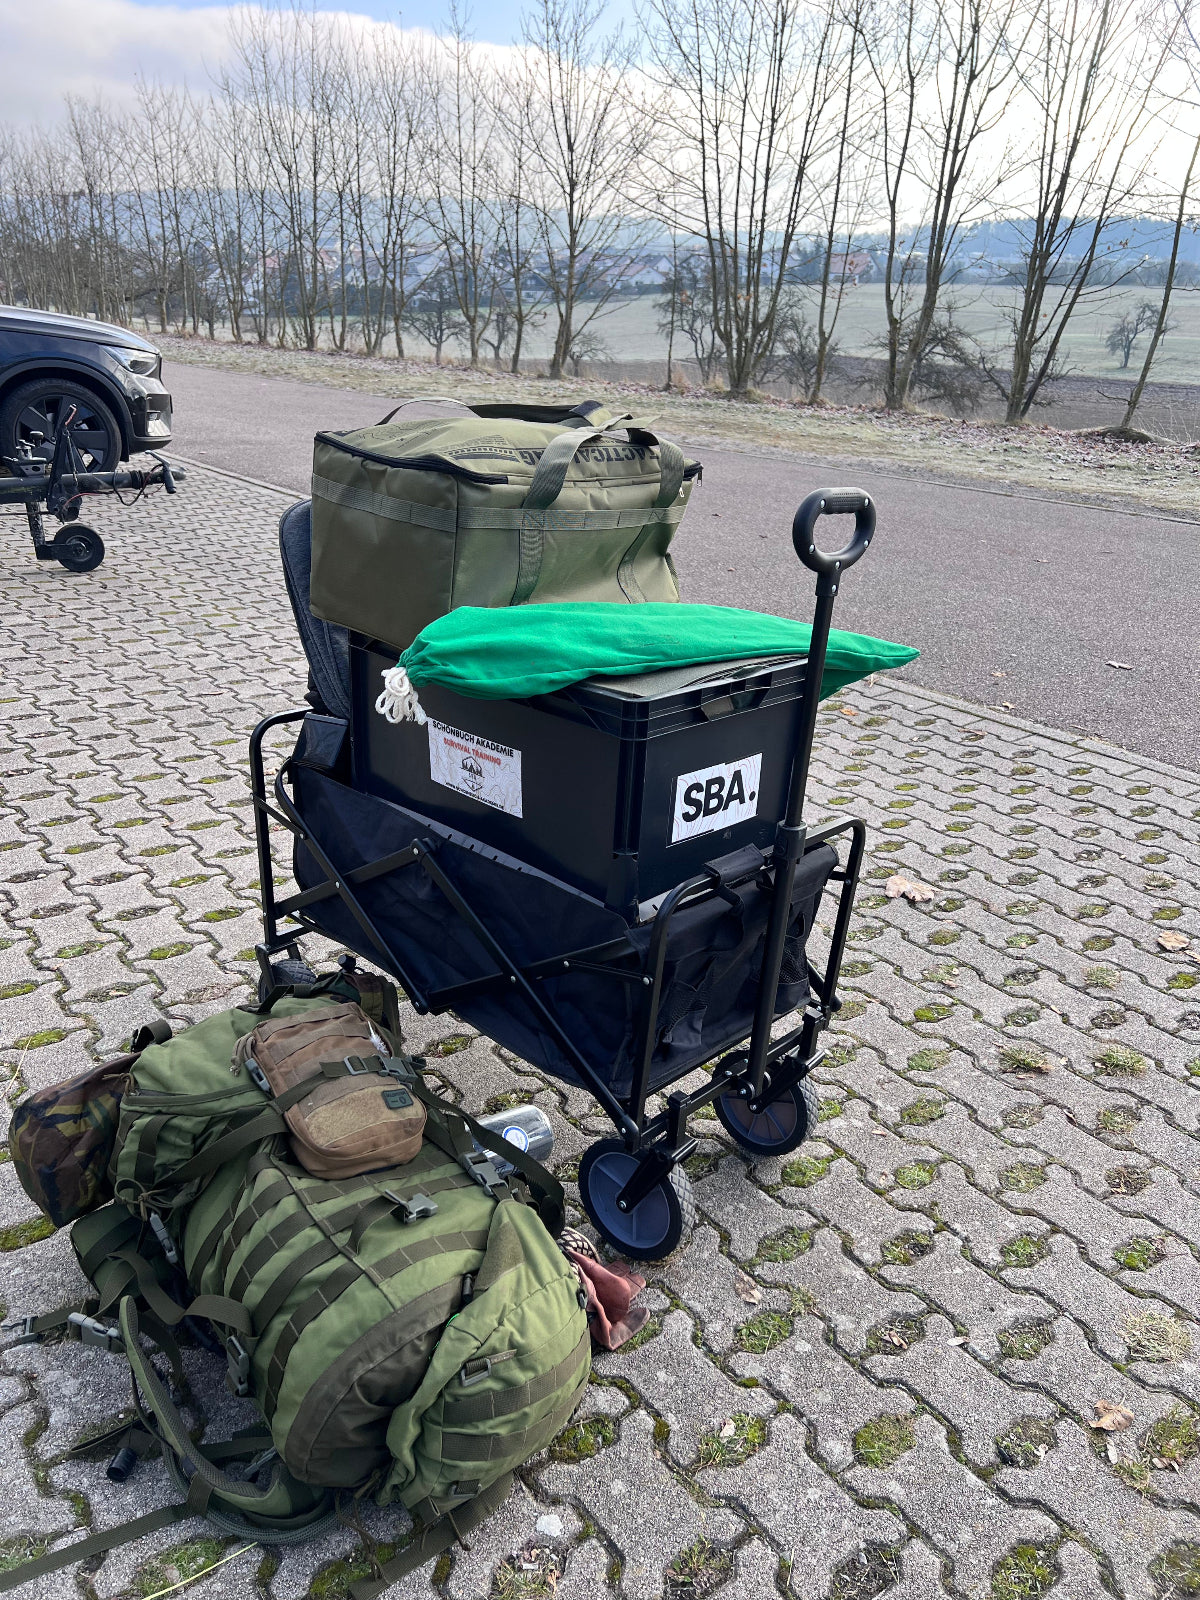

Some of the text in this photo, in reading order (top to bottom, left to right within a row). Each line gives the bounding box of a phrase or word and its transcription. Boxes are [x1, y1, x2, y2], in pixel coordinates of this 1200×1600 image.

[519, 450, 545, 466] AG
[443, 737, 502, 766] SURVIVAL TRAINING
[476, 738, 514, 757] AKADEMIE
[681, 769, 757, 823] SBA.
